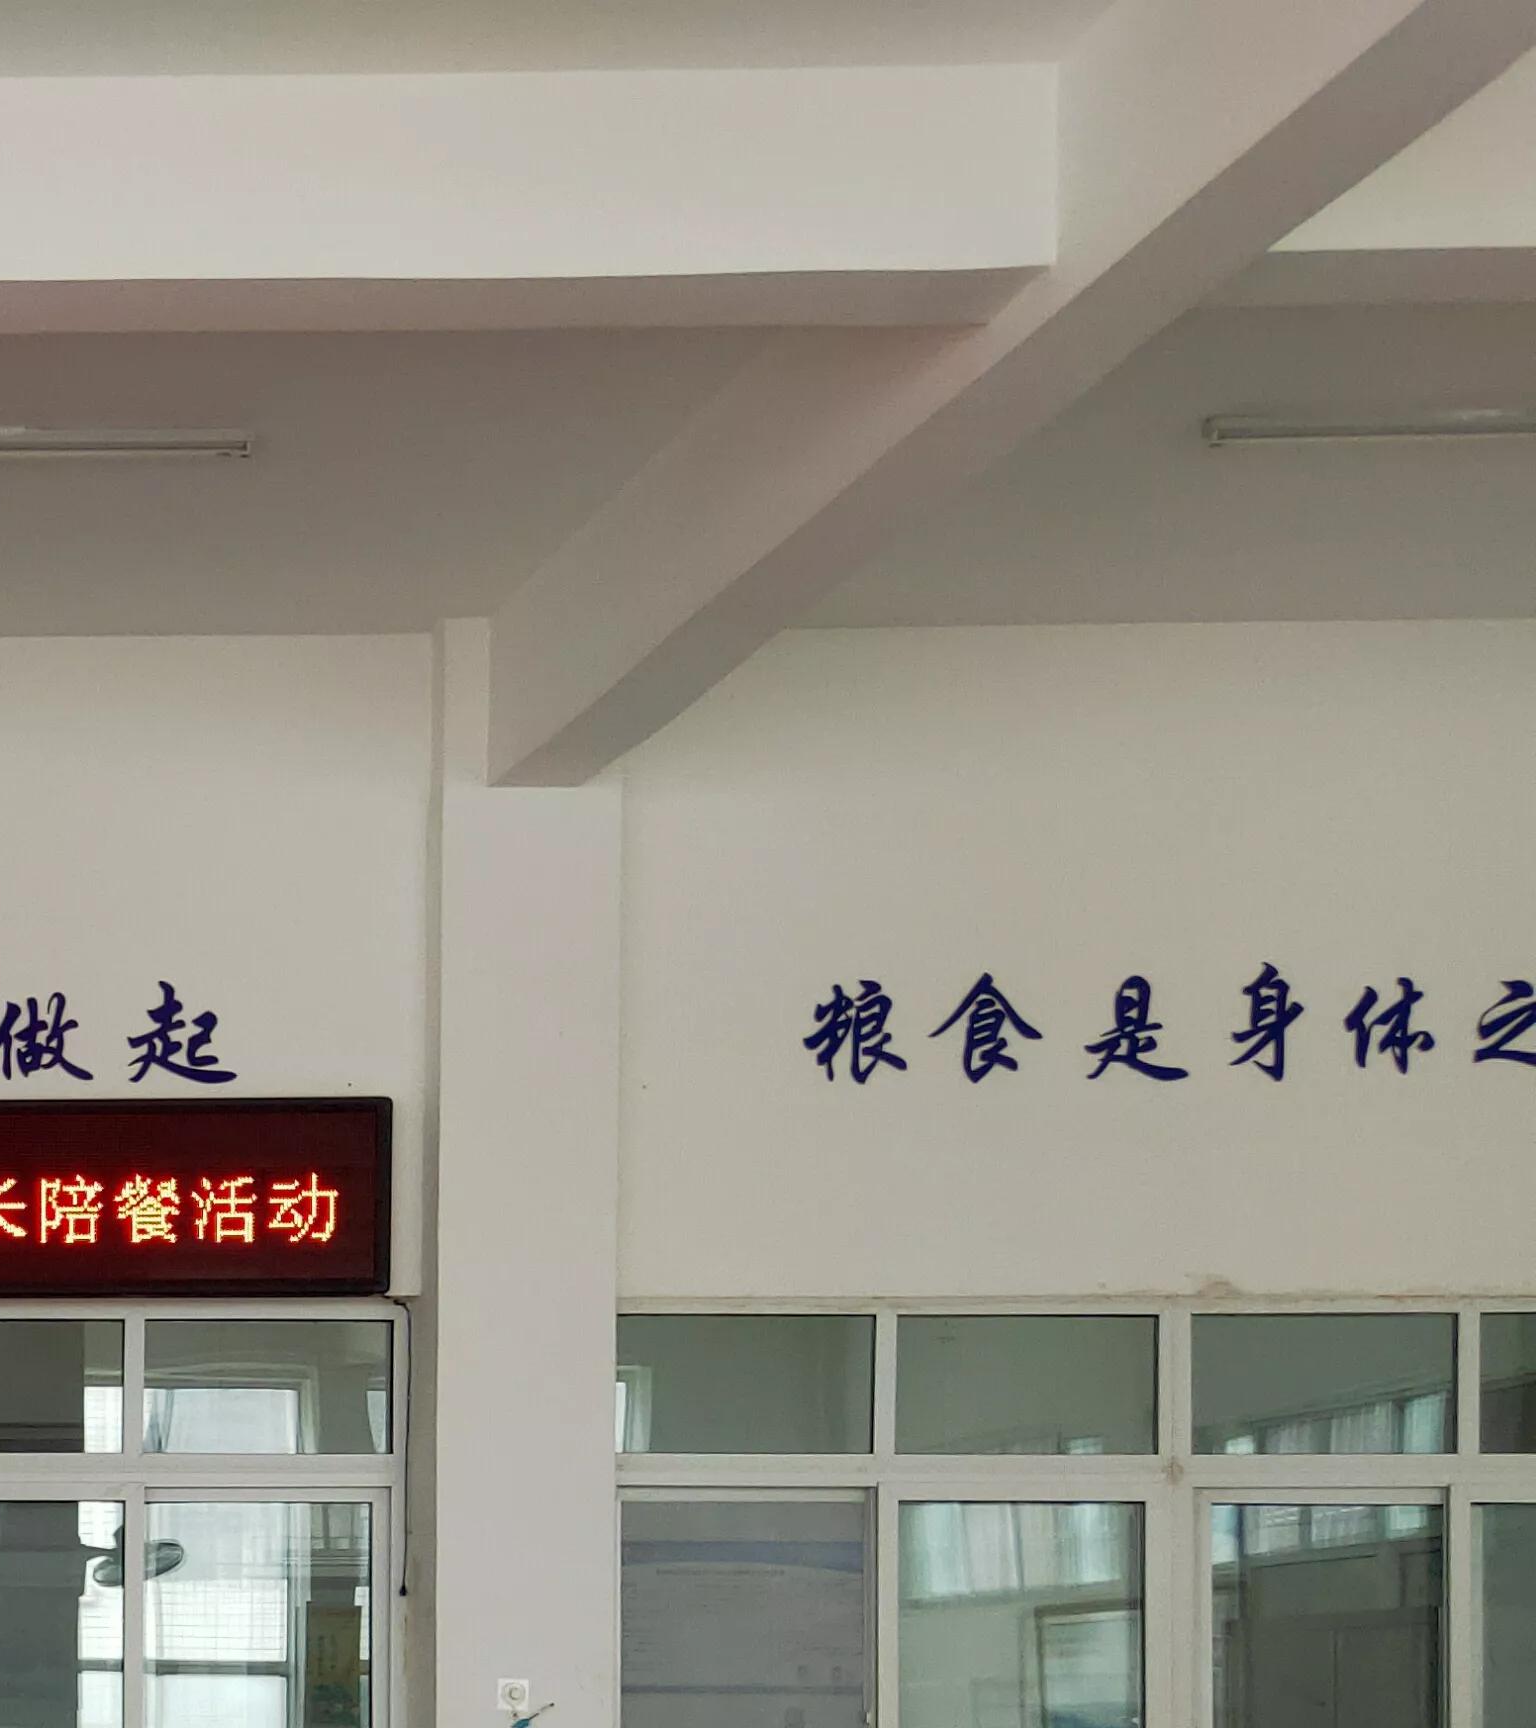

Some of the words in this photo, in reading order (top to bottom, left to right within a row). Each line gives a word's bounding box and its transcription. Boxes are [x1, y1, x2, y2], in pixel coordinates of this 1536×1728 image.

[802, 961, 1536, 1085] 粮食是身体之
